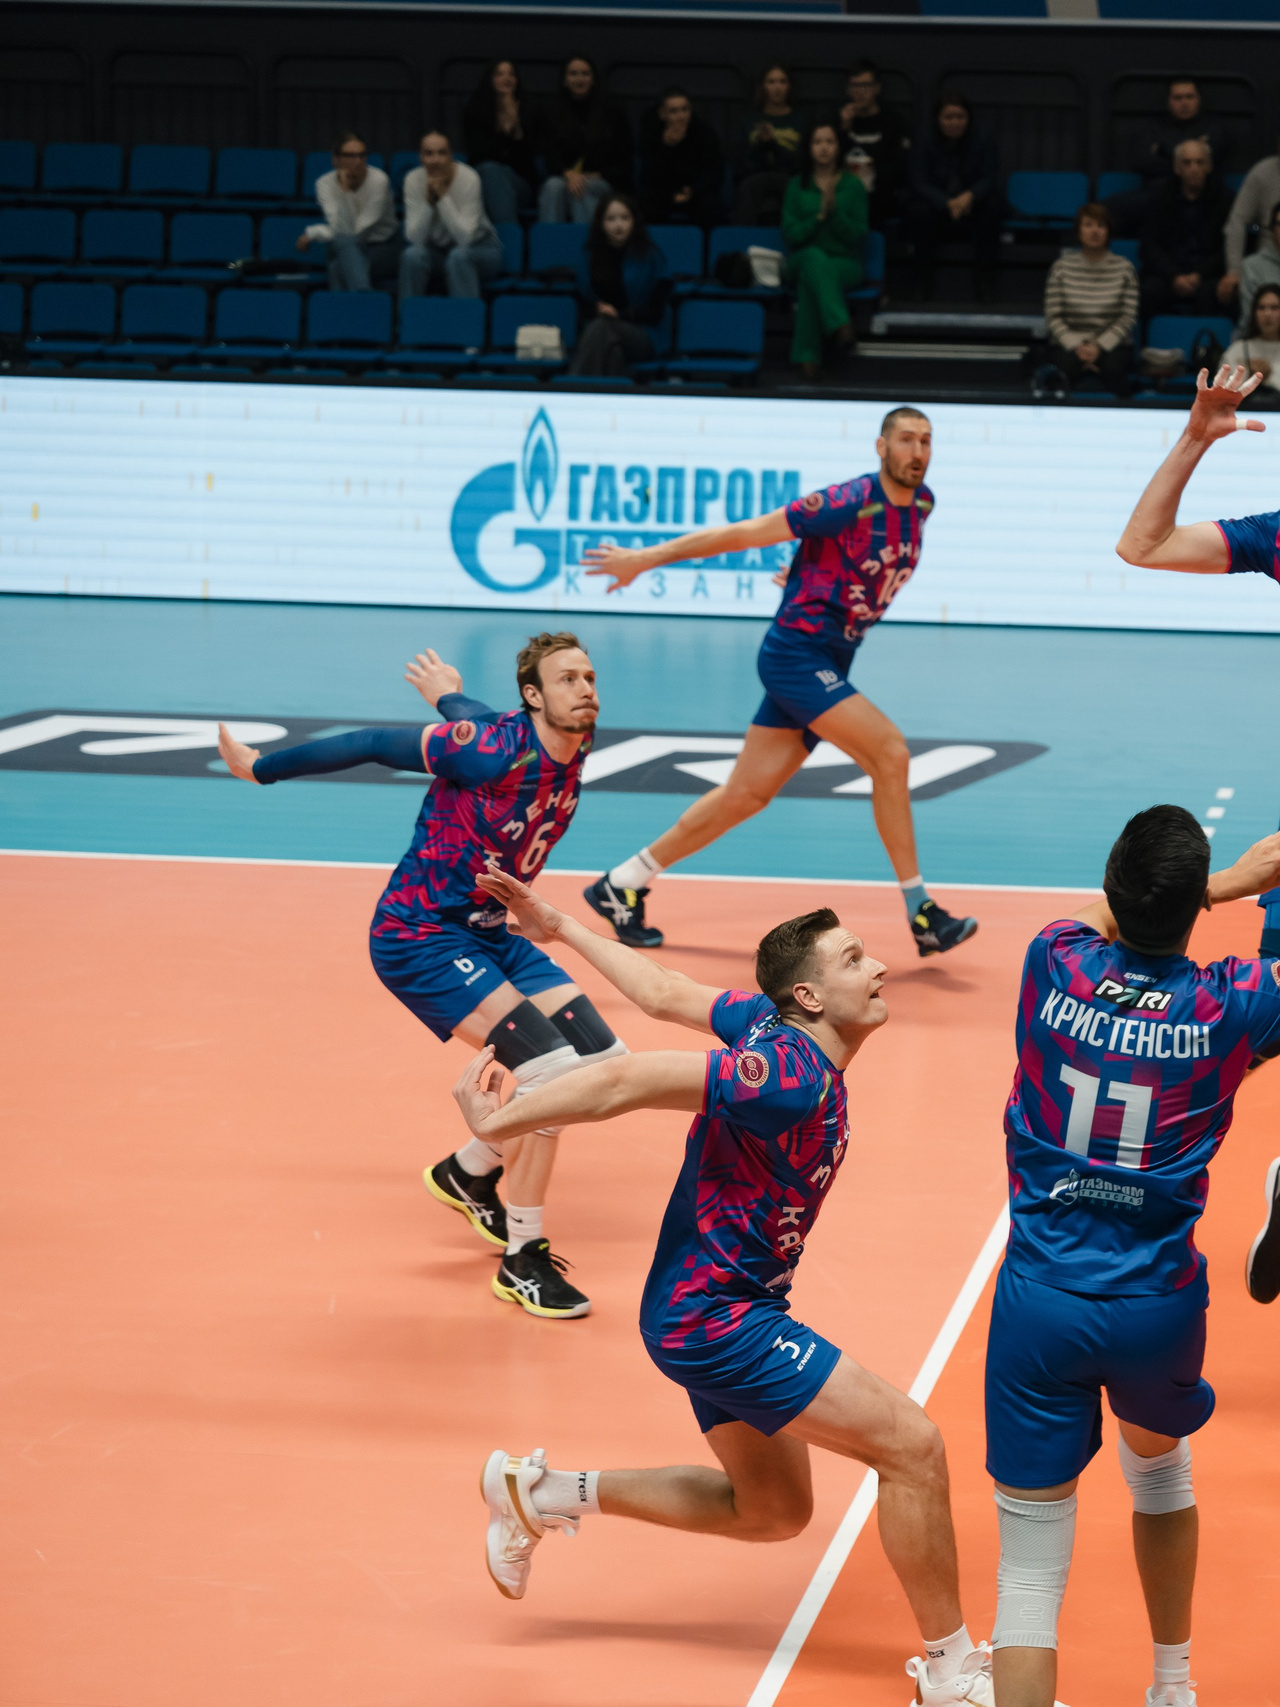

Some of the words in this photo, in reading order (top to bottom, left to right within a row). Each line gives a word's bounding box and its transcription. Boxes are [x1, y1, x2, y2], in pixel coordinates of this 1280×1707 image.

[567, 463, 800, 525] ГАЗПРОМ
[521, 821, 555, 875] 6
[453, 954, 475, 973] 6
[1095, 978, 1173, 1010] PARI
[1040, 987, 1210, 1059] КРИСТЕНСОН
[1059, 1063, 1153, 1169] 11
[1080, 1178, 1145, 1197] ГАЗПРОМ
[796, 1341, 817, 1371] ENSEN
